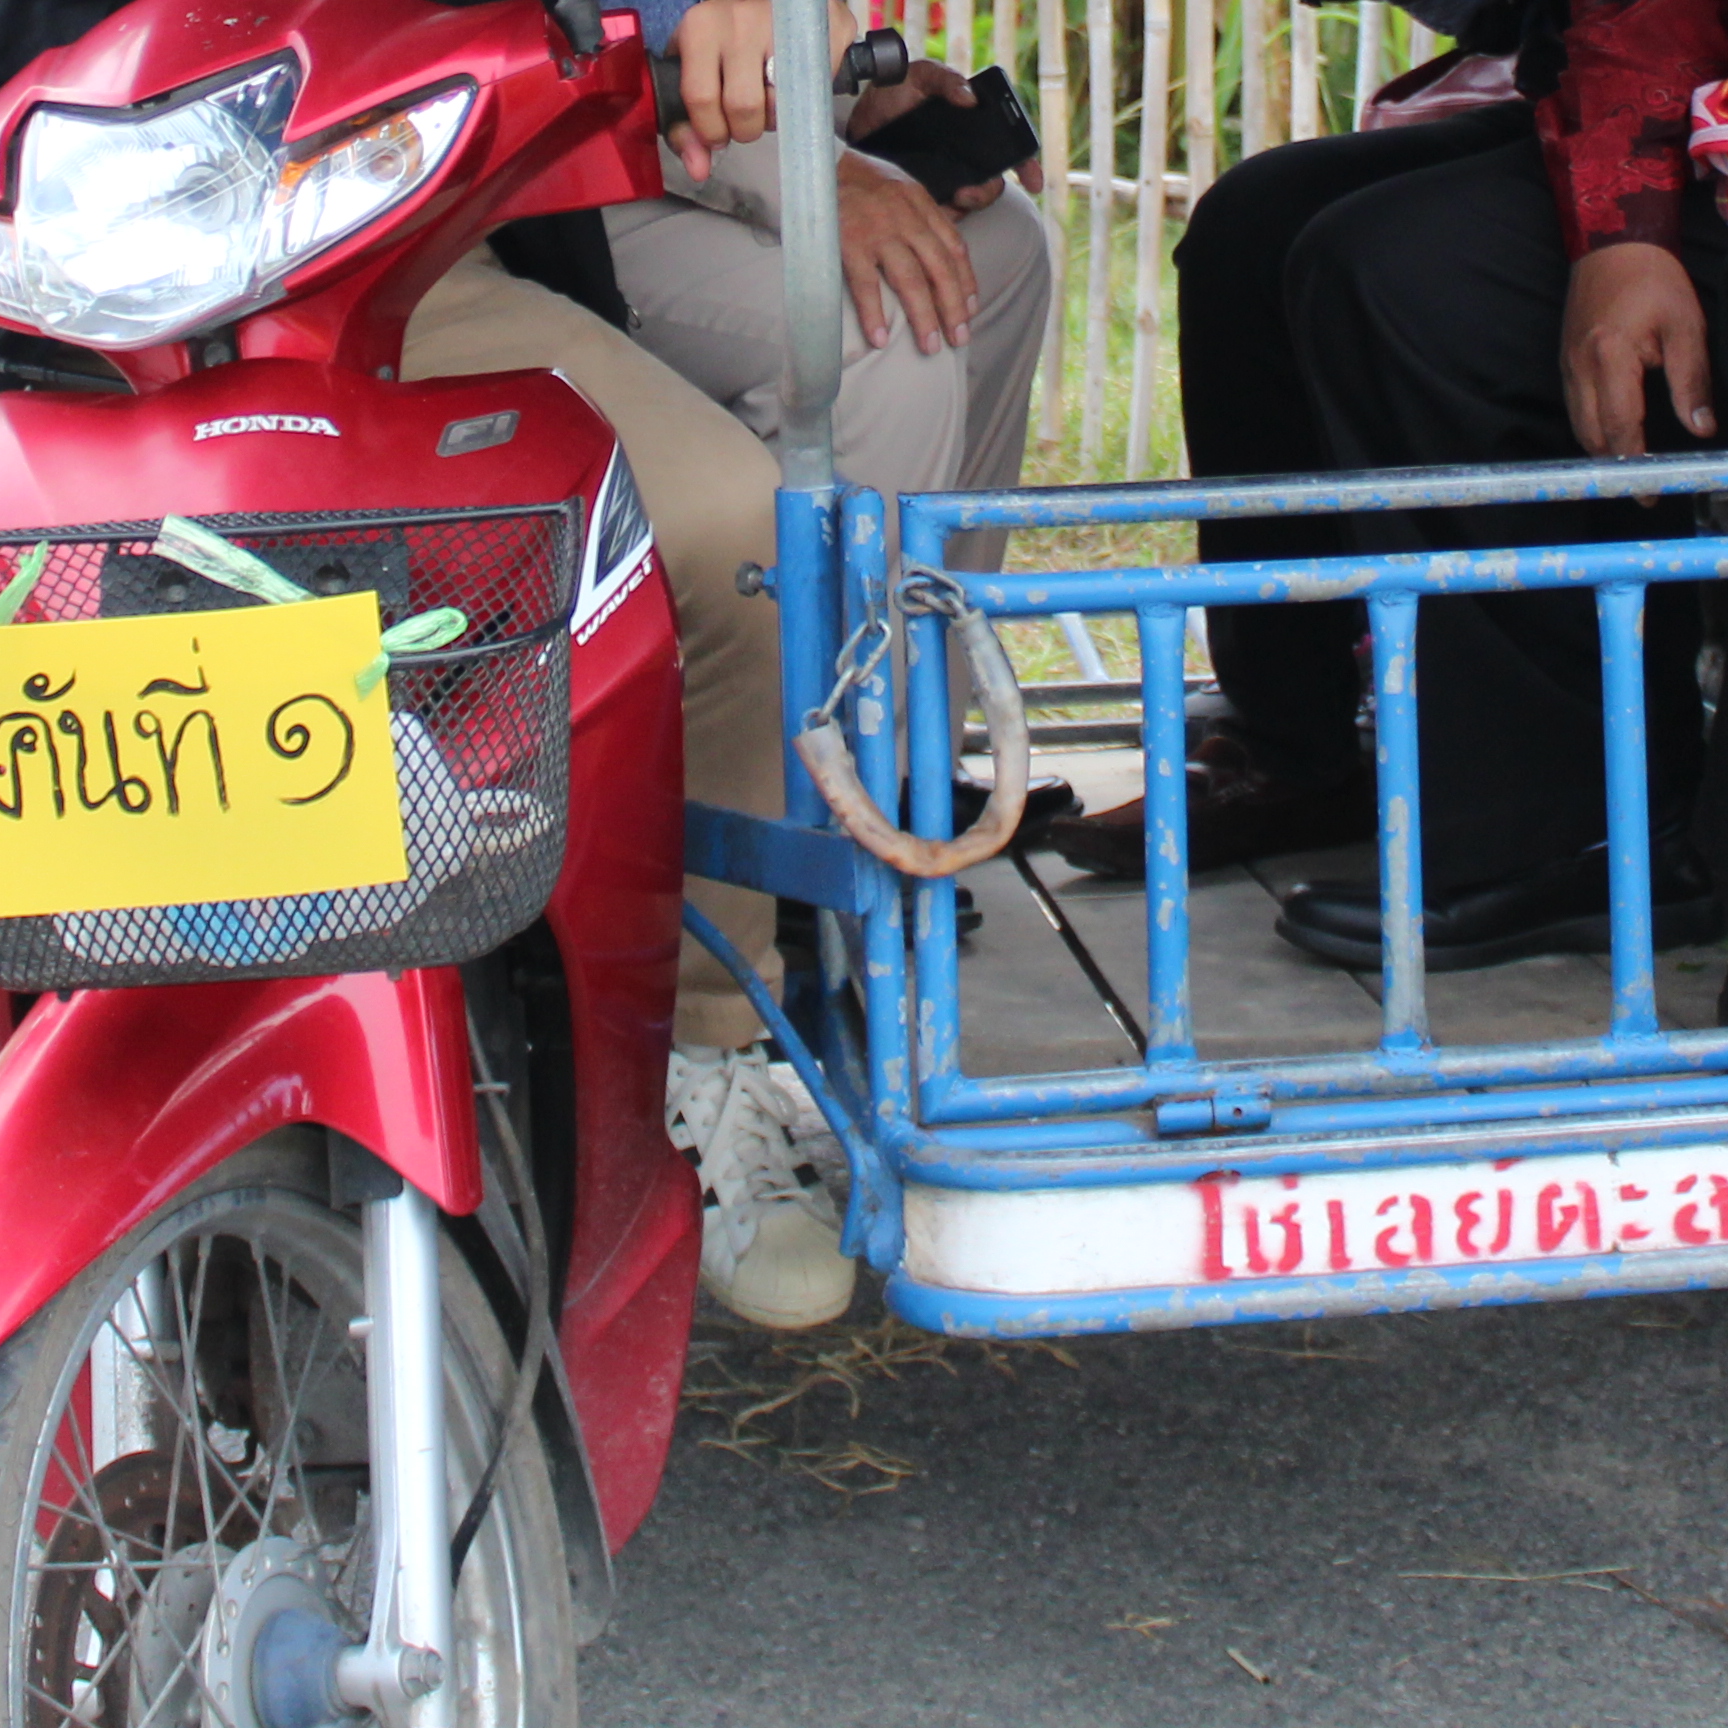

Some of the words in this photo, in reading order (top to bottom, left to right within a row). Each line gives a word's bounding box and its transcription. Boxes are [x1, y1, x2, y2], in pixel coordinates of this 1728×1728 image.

[192, 414, 341, 442] HONDA
[446, 414, 512, 446] FI
[266, 692, 355, 805] ๑
